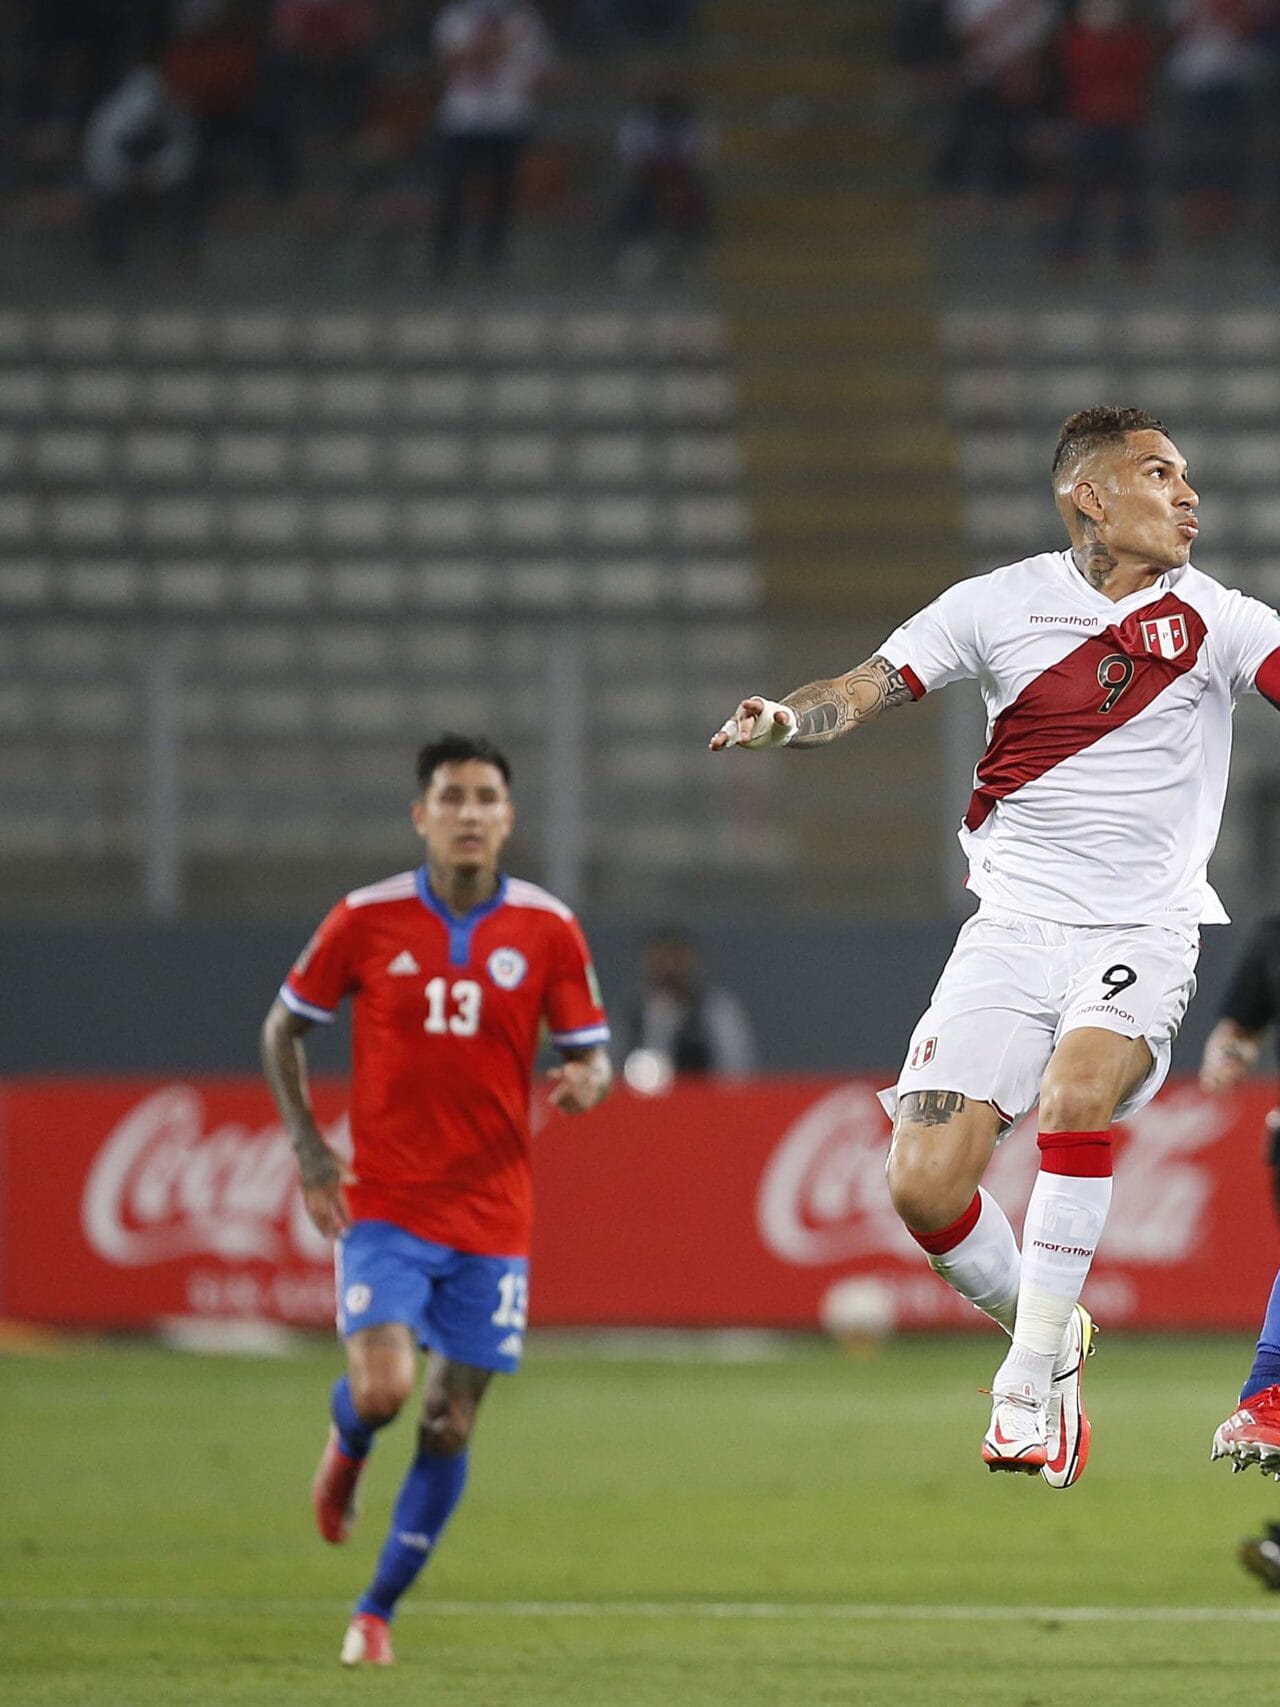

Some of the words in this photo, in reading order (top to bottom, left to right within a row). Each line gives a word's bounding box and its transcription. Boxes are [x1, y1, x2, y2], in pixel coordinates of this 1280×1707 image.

[1029, 613, 1098, 627] marathon
[1097, 653, 1135, 714] 9
[1101, 963, 1138, 1001] 9
[424, 977, 482, 1038] 13
